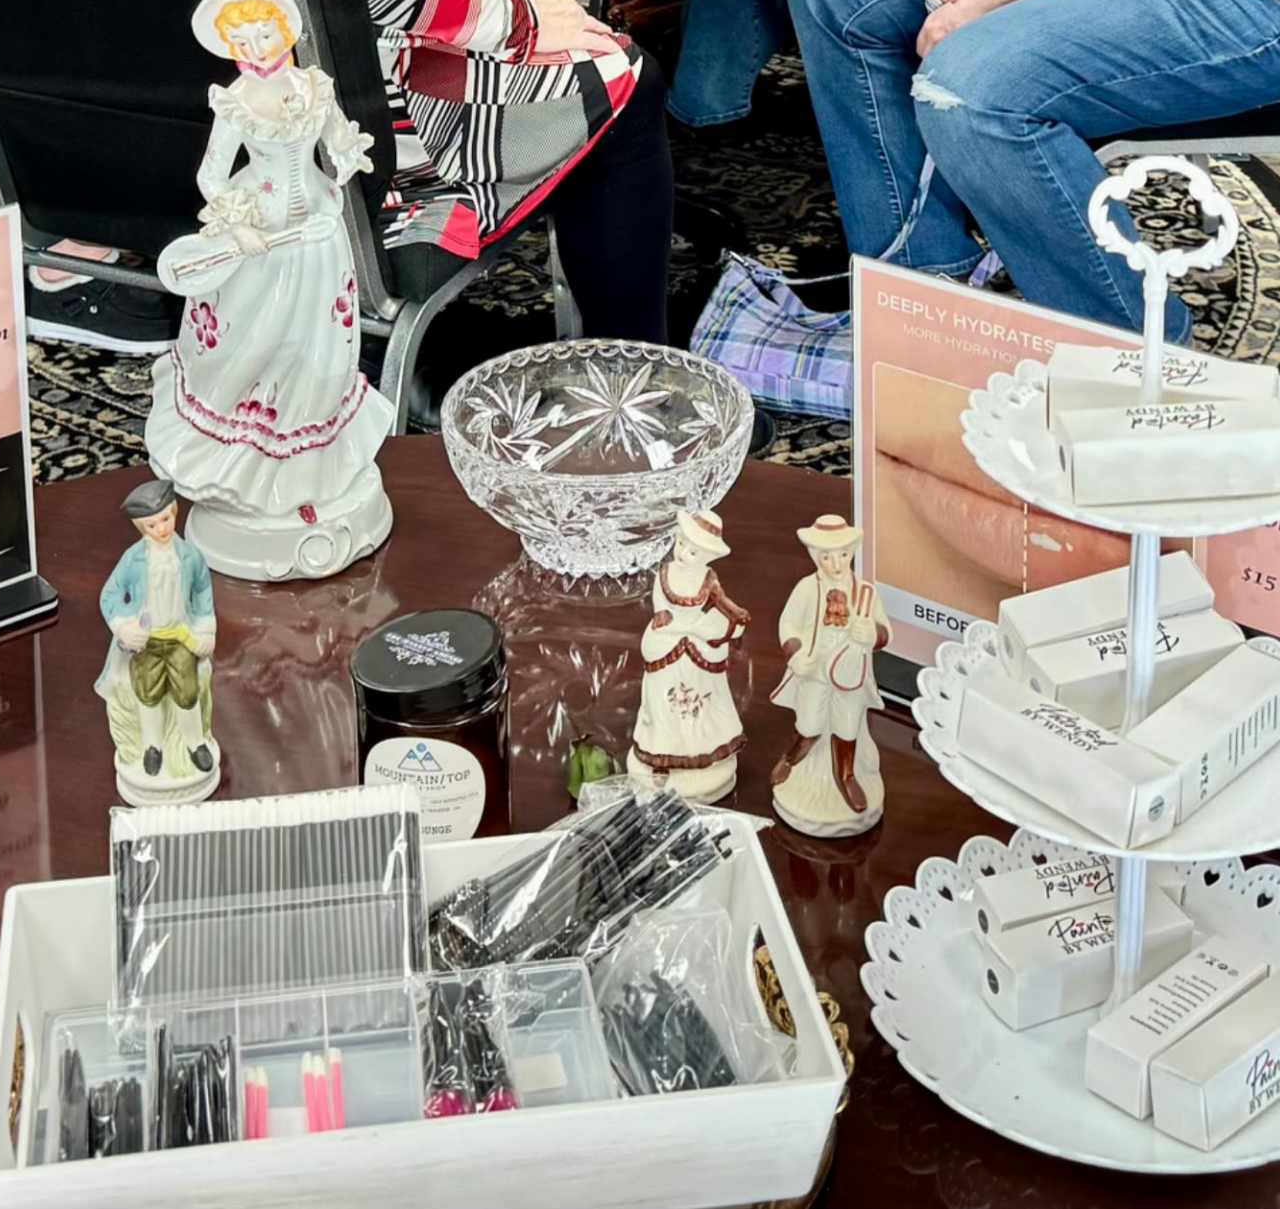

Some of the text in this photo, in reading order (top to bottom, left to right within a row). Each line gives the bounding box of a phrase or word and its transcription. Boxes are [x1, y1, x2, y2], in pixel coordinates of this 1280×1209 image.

[877, 291, 1055, 354] DEEPLY HYDRATES
[903, 323, 942, 345] MORE
[1241, 567, 1278, 592] $15
[1034, 858, 1089, 881] WENDY
